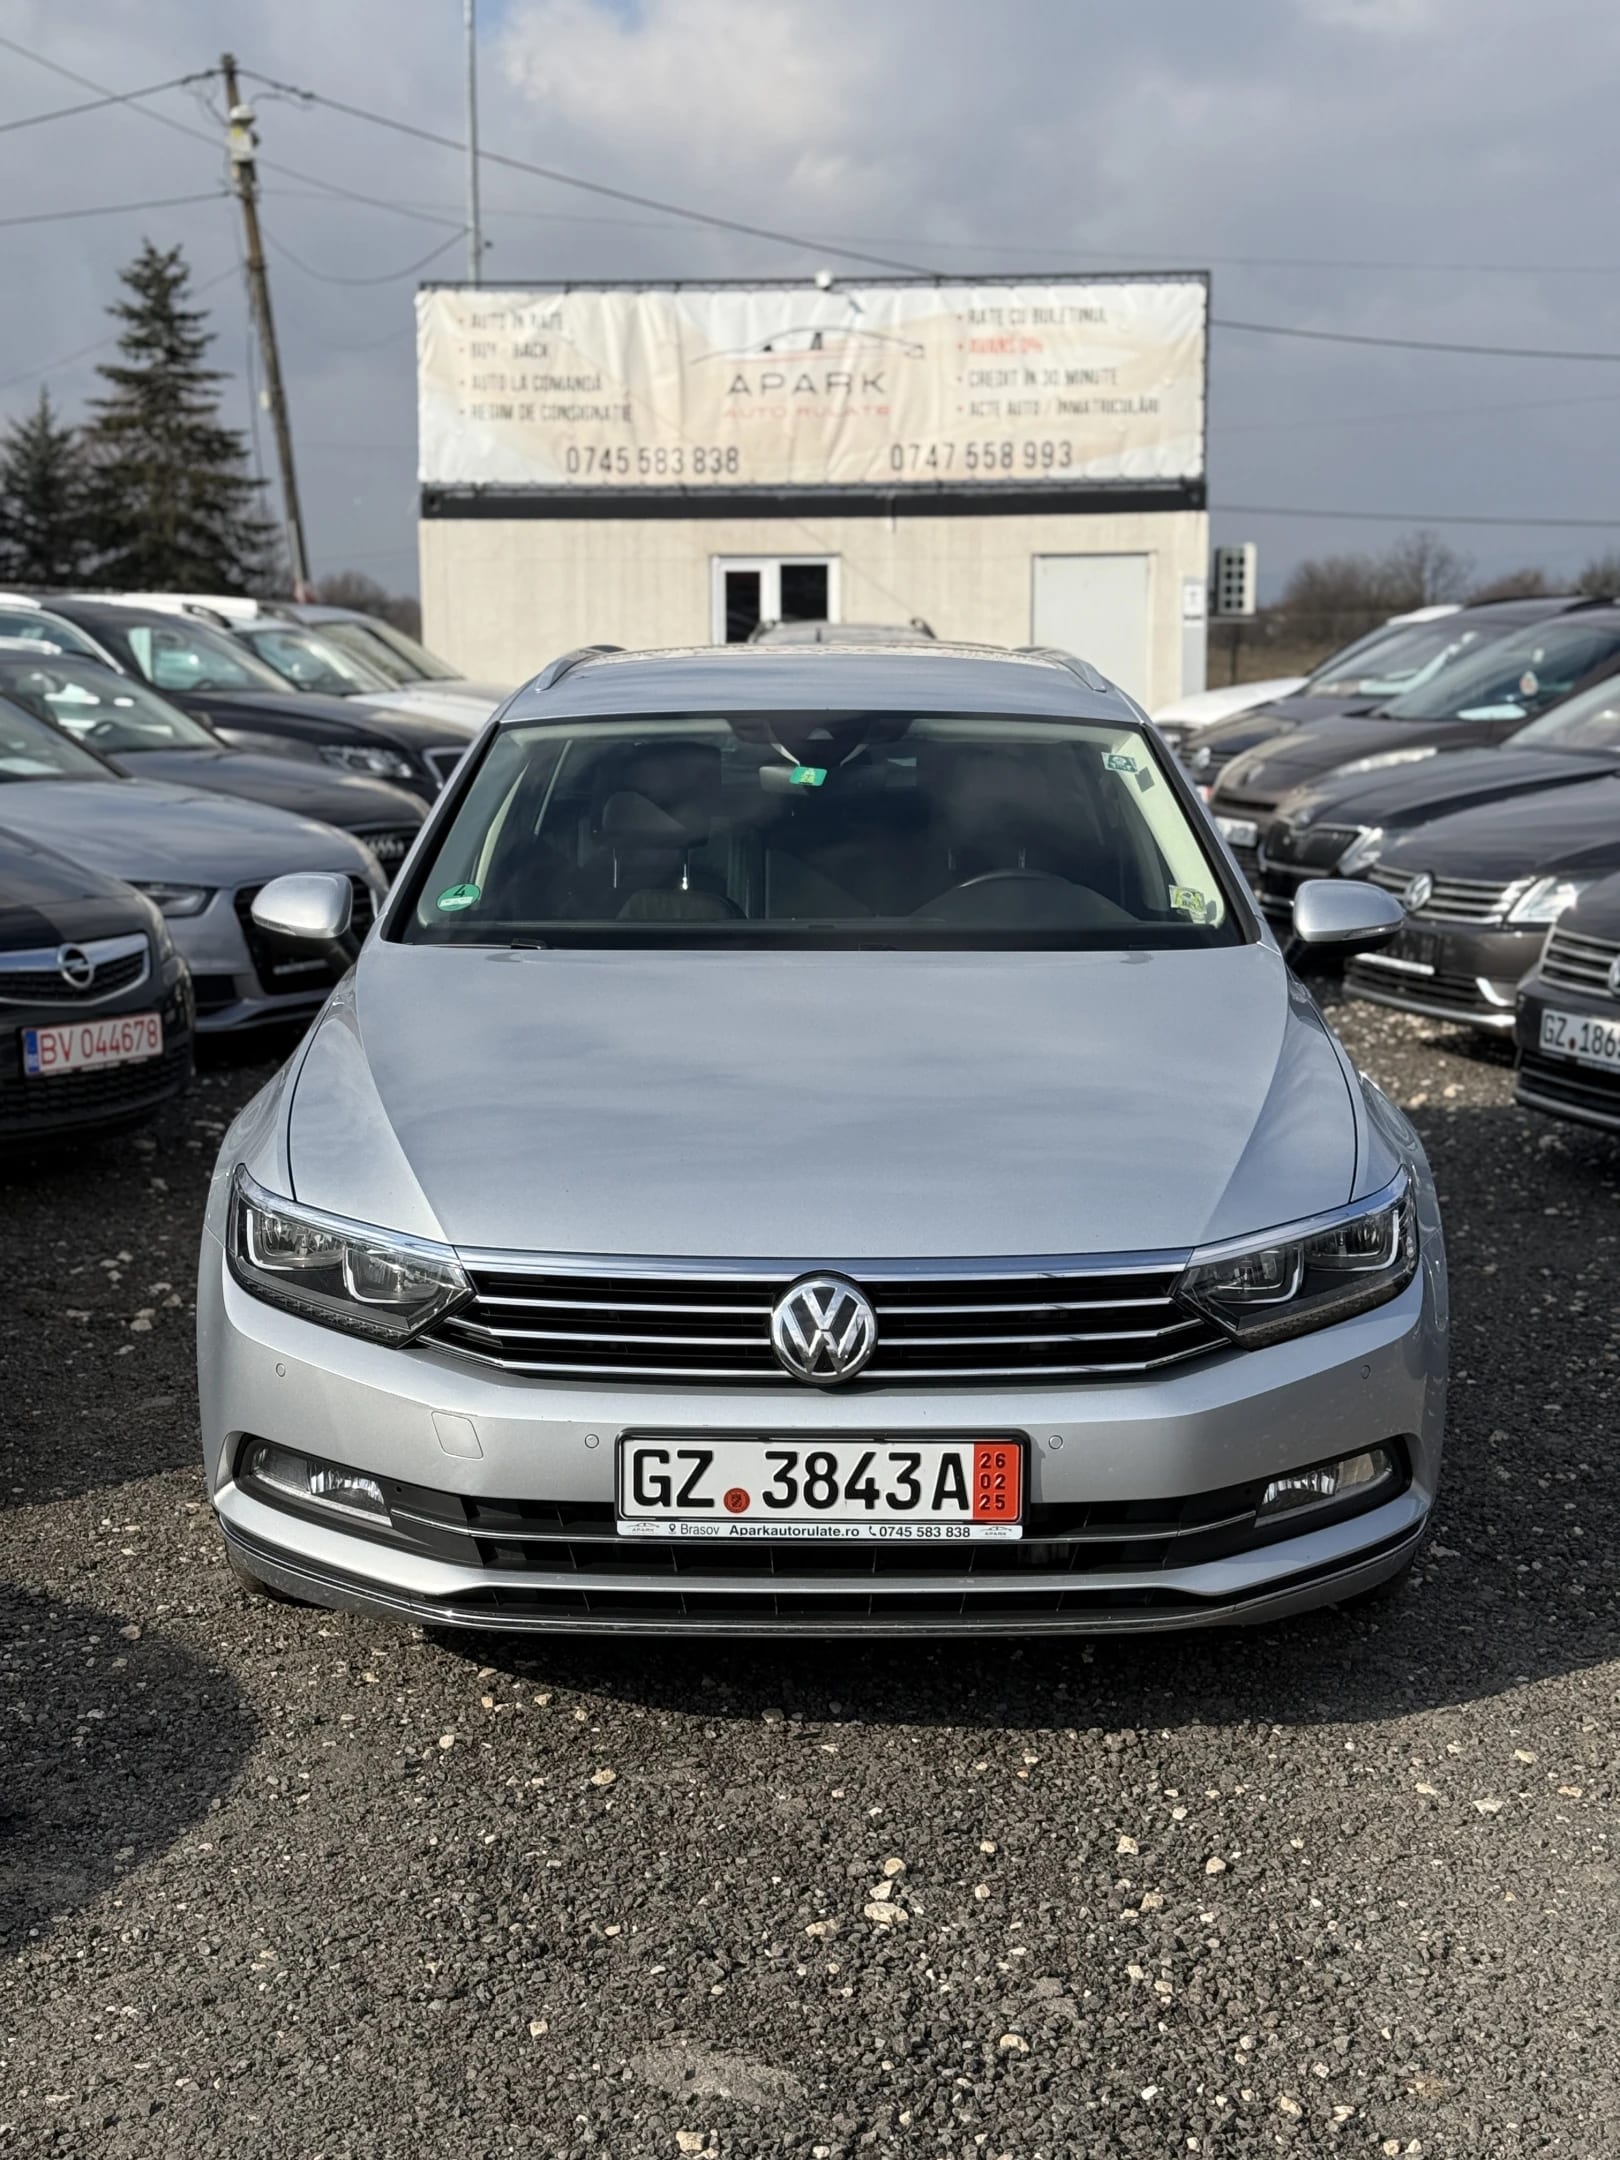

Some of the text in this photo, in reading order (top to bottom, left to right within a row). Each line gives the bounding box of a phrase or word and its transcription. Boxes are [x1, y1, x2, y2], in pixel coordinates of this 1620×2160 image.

[727, 371, 886, 396] APARK
[566, 445, 740, 474] 0745 583 838
[889, 440, 1073, 471] 0747 558 993
[453, 884, 466, 898] 4
[39, 1019, 158, 1065] BV 044678
[1543, 1014, 1620, 1059] GZ 186
[979, 1452, 1007, 1469] 26
[633, 1449, 970, 1511] GZ 3843A
[979, 1473, 1007, 1490] 02
[979, 1494, 1007, 1511] 25
[680, 1523, 971, 1539] Brasov Aparkautorulate.ro 0745 583 838
